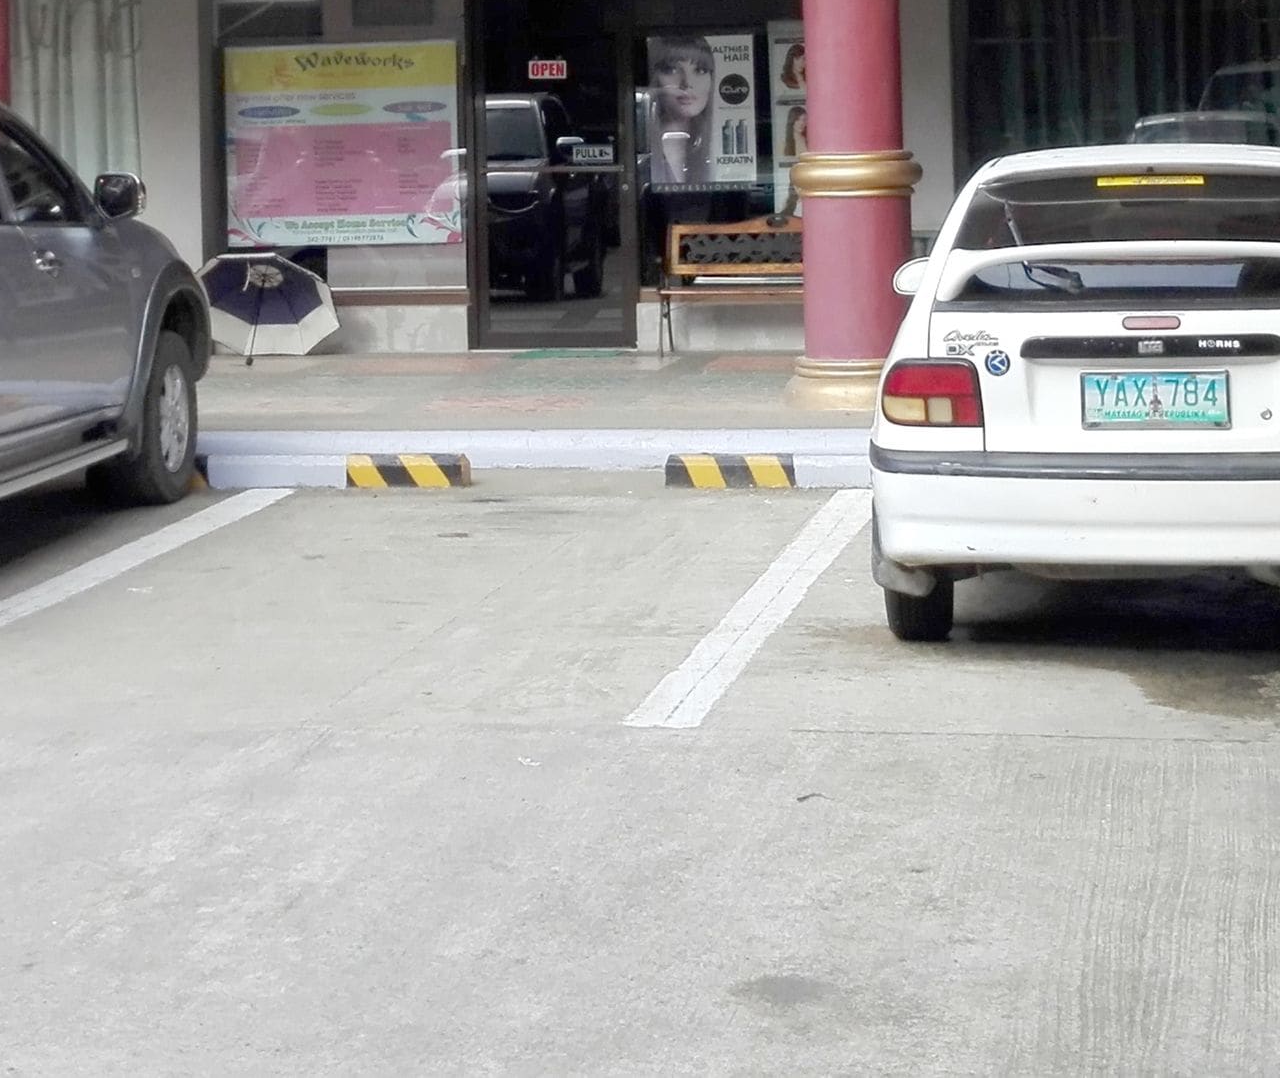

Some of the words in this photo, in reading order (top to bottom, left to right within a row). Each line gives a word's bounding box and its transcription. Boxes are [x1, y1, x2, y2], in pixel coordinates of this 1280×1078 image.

[294, 51, 415, 72] Waveworks
[723, 54, 750, 62] HAIR
[531, 63, 565, 77] OPEN
[575, 148, 597, 159] PULL
[716, 155, 754, 165] KERATIN
[1095, 379, 1147, 407] YAX
[1164, 379, 1218, 407] 784
